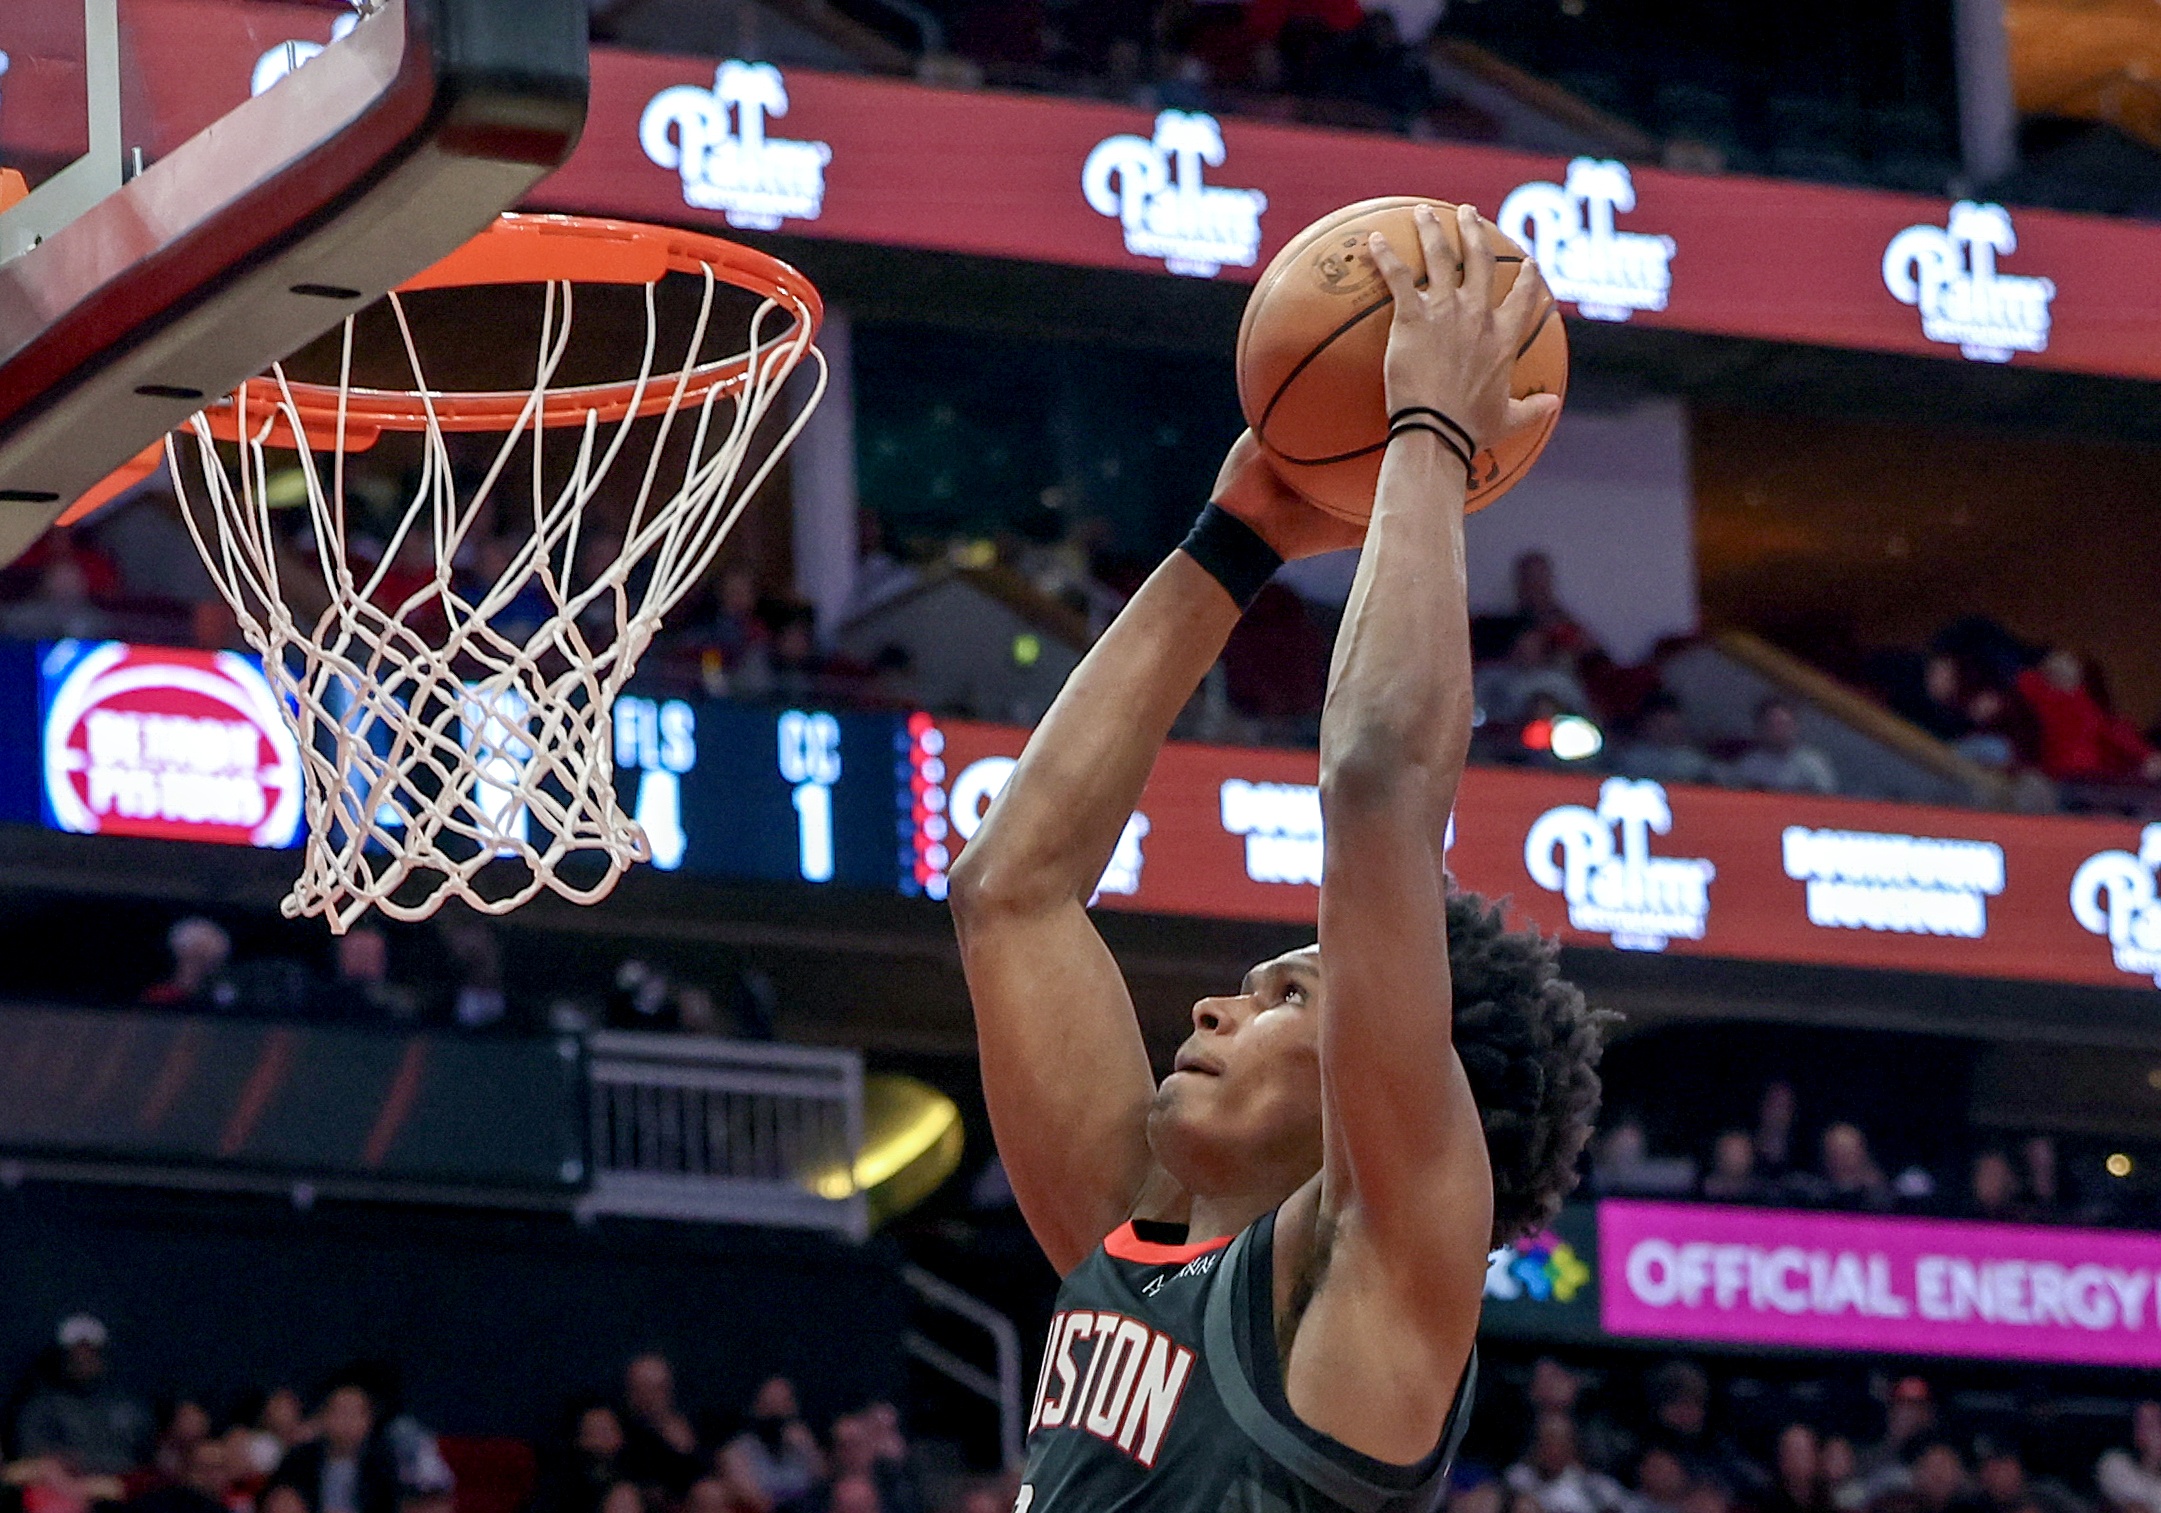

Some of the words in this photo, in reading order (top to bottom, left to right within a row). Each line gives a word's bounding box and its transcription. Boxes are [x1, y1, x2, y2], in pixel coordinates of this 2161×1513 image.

[614, 695, 697, 773] FLS
[791, 783, 835, 883] 1
[1626, 1237, 1908, 1318] OFFICIAL
[1914, 1255, 2150, 1331] ENERGY
